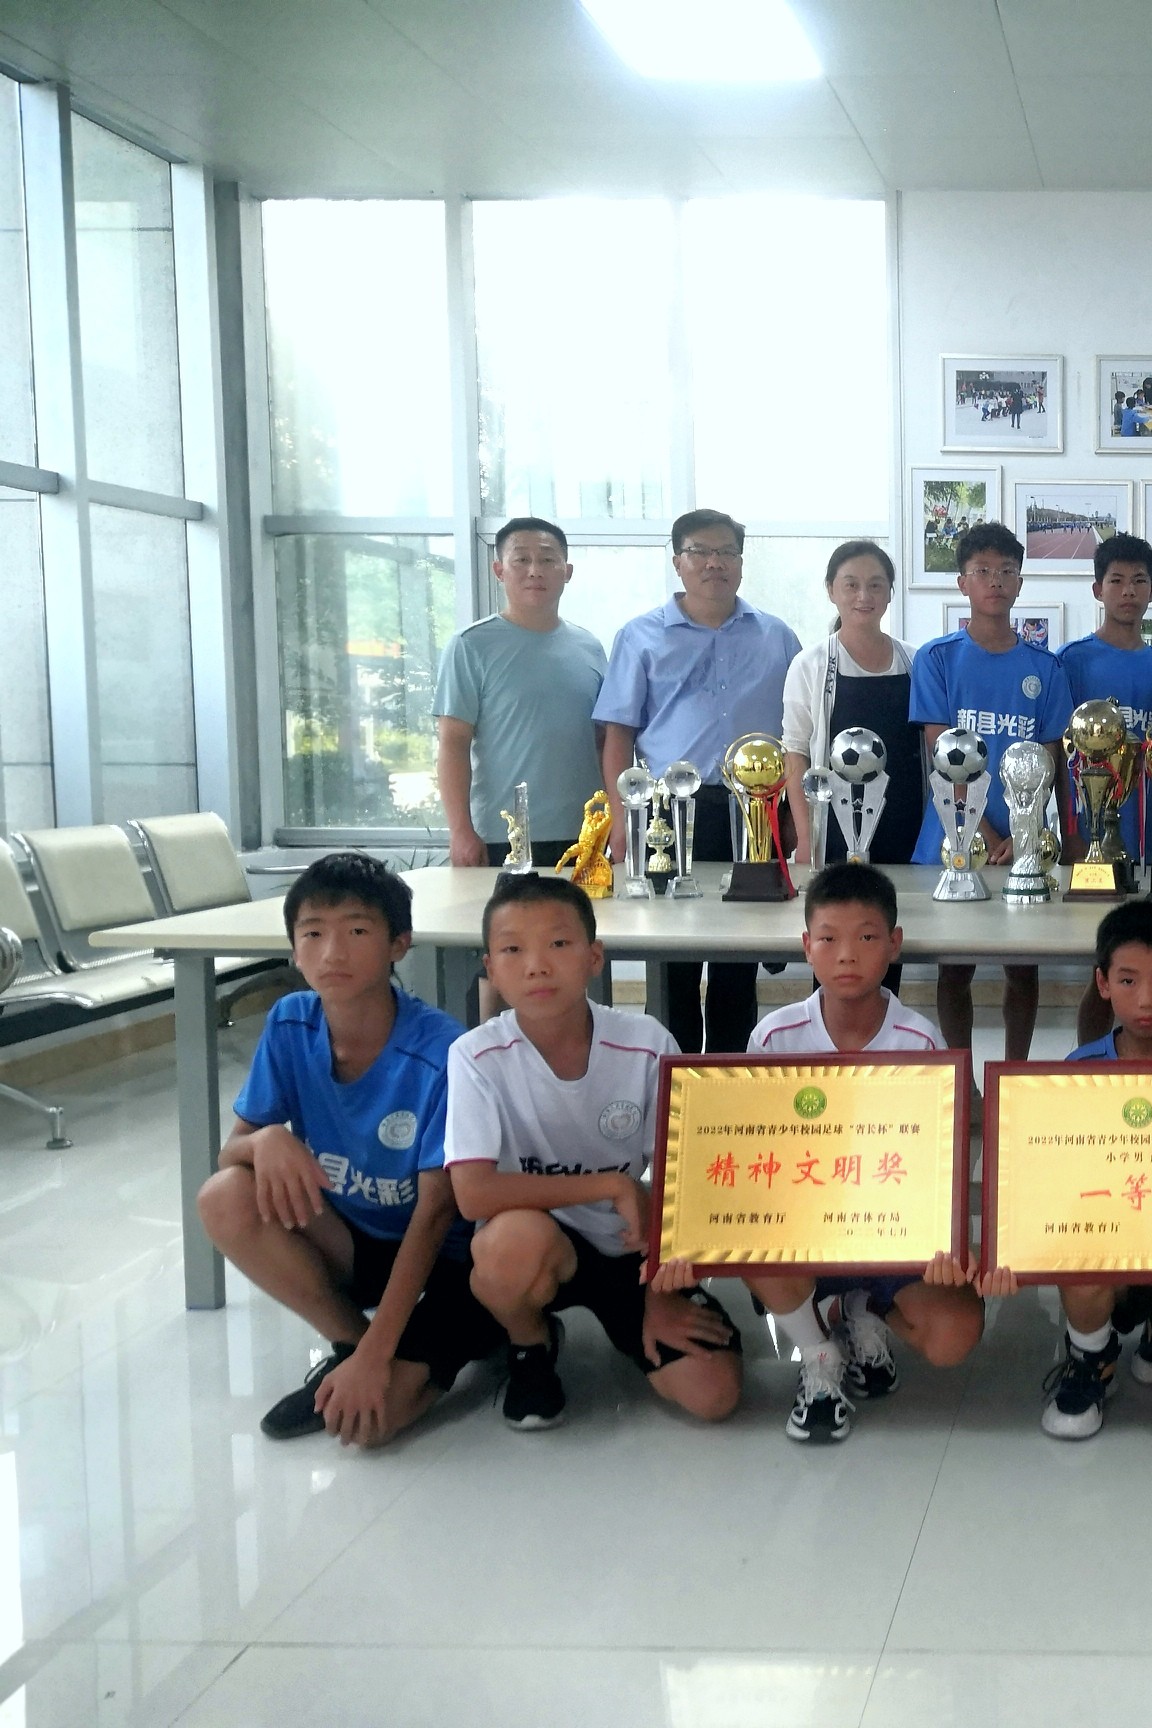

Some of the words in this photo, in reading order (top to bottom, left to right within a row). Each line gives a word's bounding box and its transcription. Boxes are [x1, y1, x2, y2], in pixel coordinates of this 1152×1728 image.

[957, 708, 1036, 740] 新县光彩
[705, 1150, 908, 1190] 精神文明奖
[708, 1211, 787, 1224] 河南省教育厅
[823, 1211, 900, 1224] 河南省体育局
[1045, 1221, 1121, 1234] 河南省教育厅
